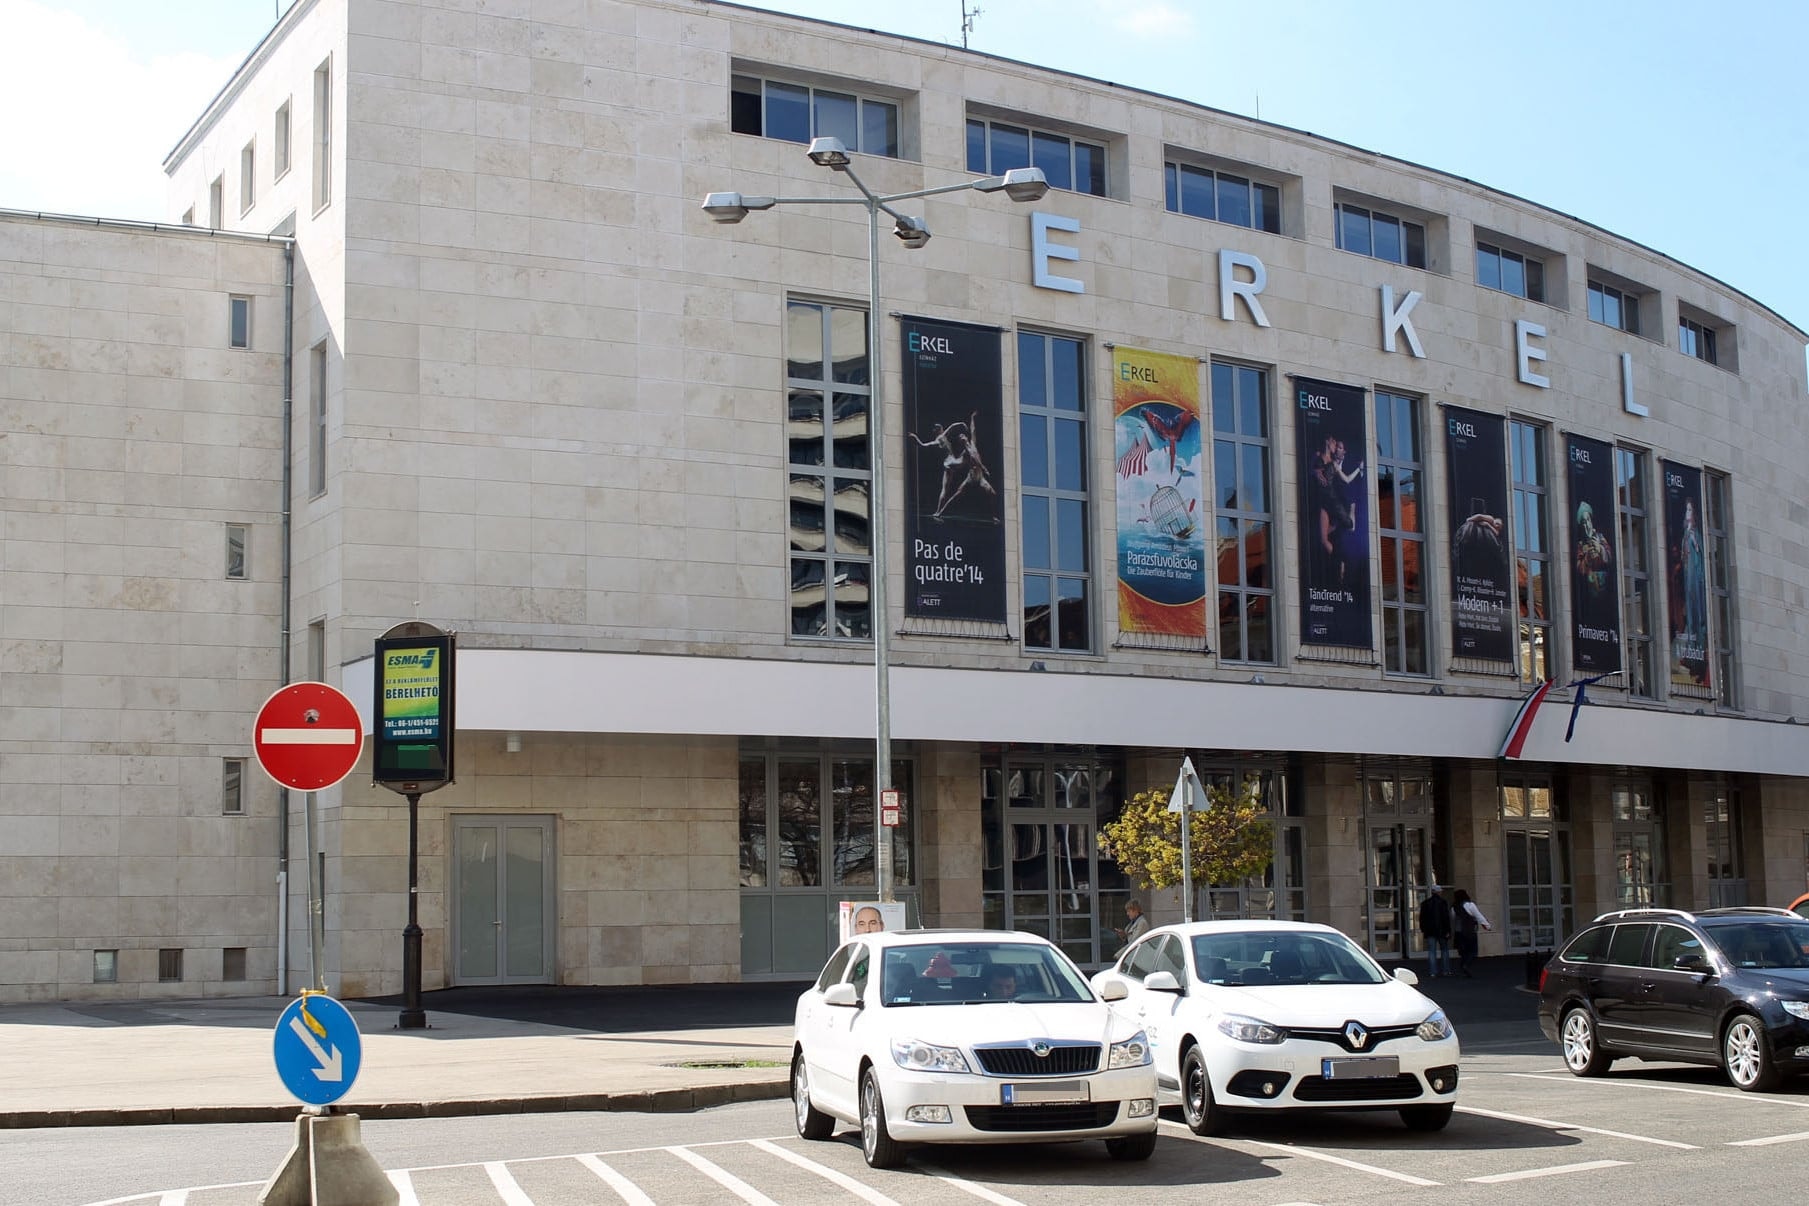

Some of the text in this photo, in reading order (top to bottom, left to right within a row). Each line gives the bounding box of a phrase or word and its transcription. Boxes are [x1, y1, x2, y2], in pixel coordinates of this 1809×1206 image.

[909, 332, 954, 354] ERKEL
[1121, 362, 1159, 383] ERKEL
[1299, 391, 1333, 411] ERKEL
[1449, 419, 1477, 438] ERKEL
[914, 539, 963, 561] Pas de
[388, 655, 419, 666] ESMA
